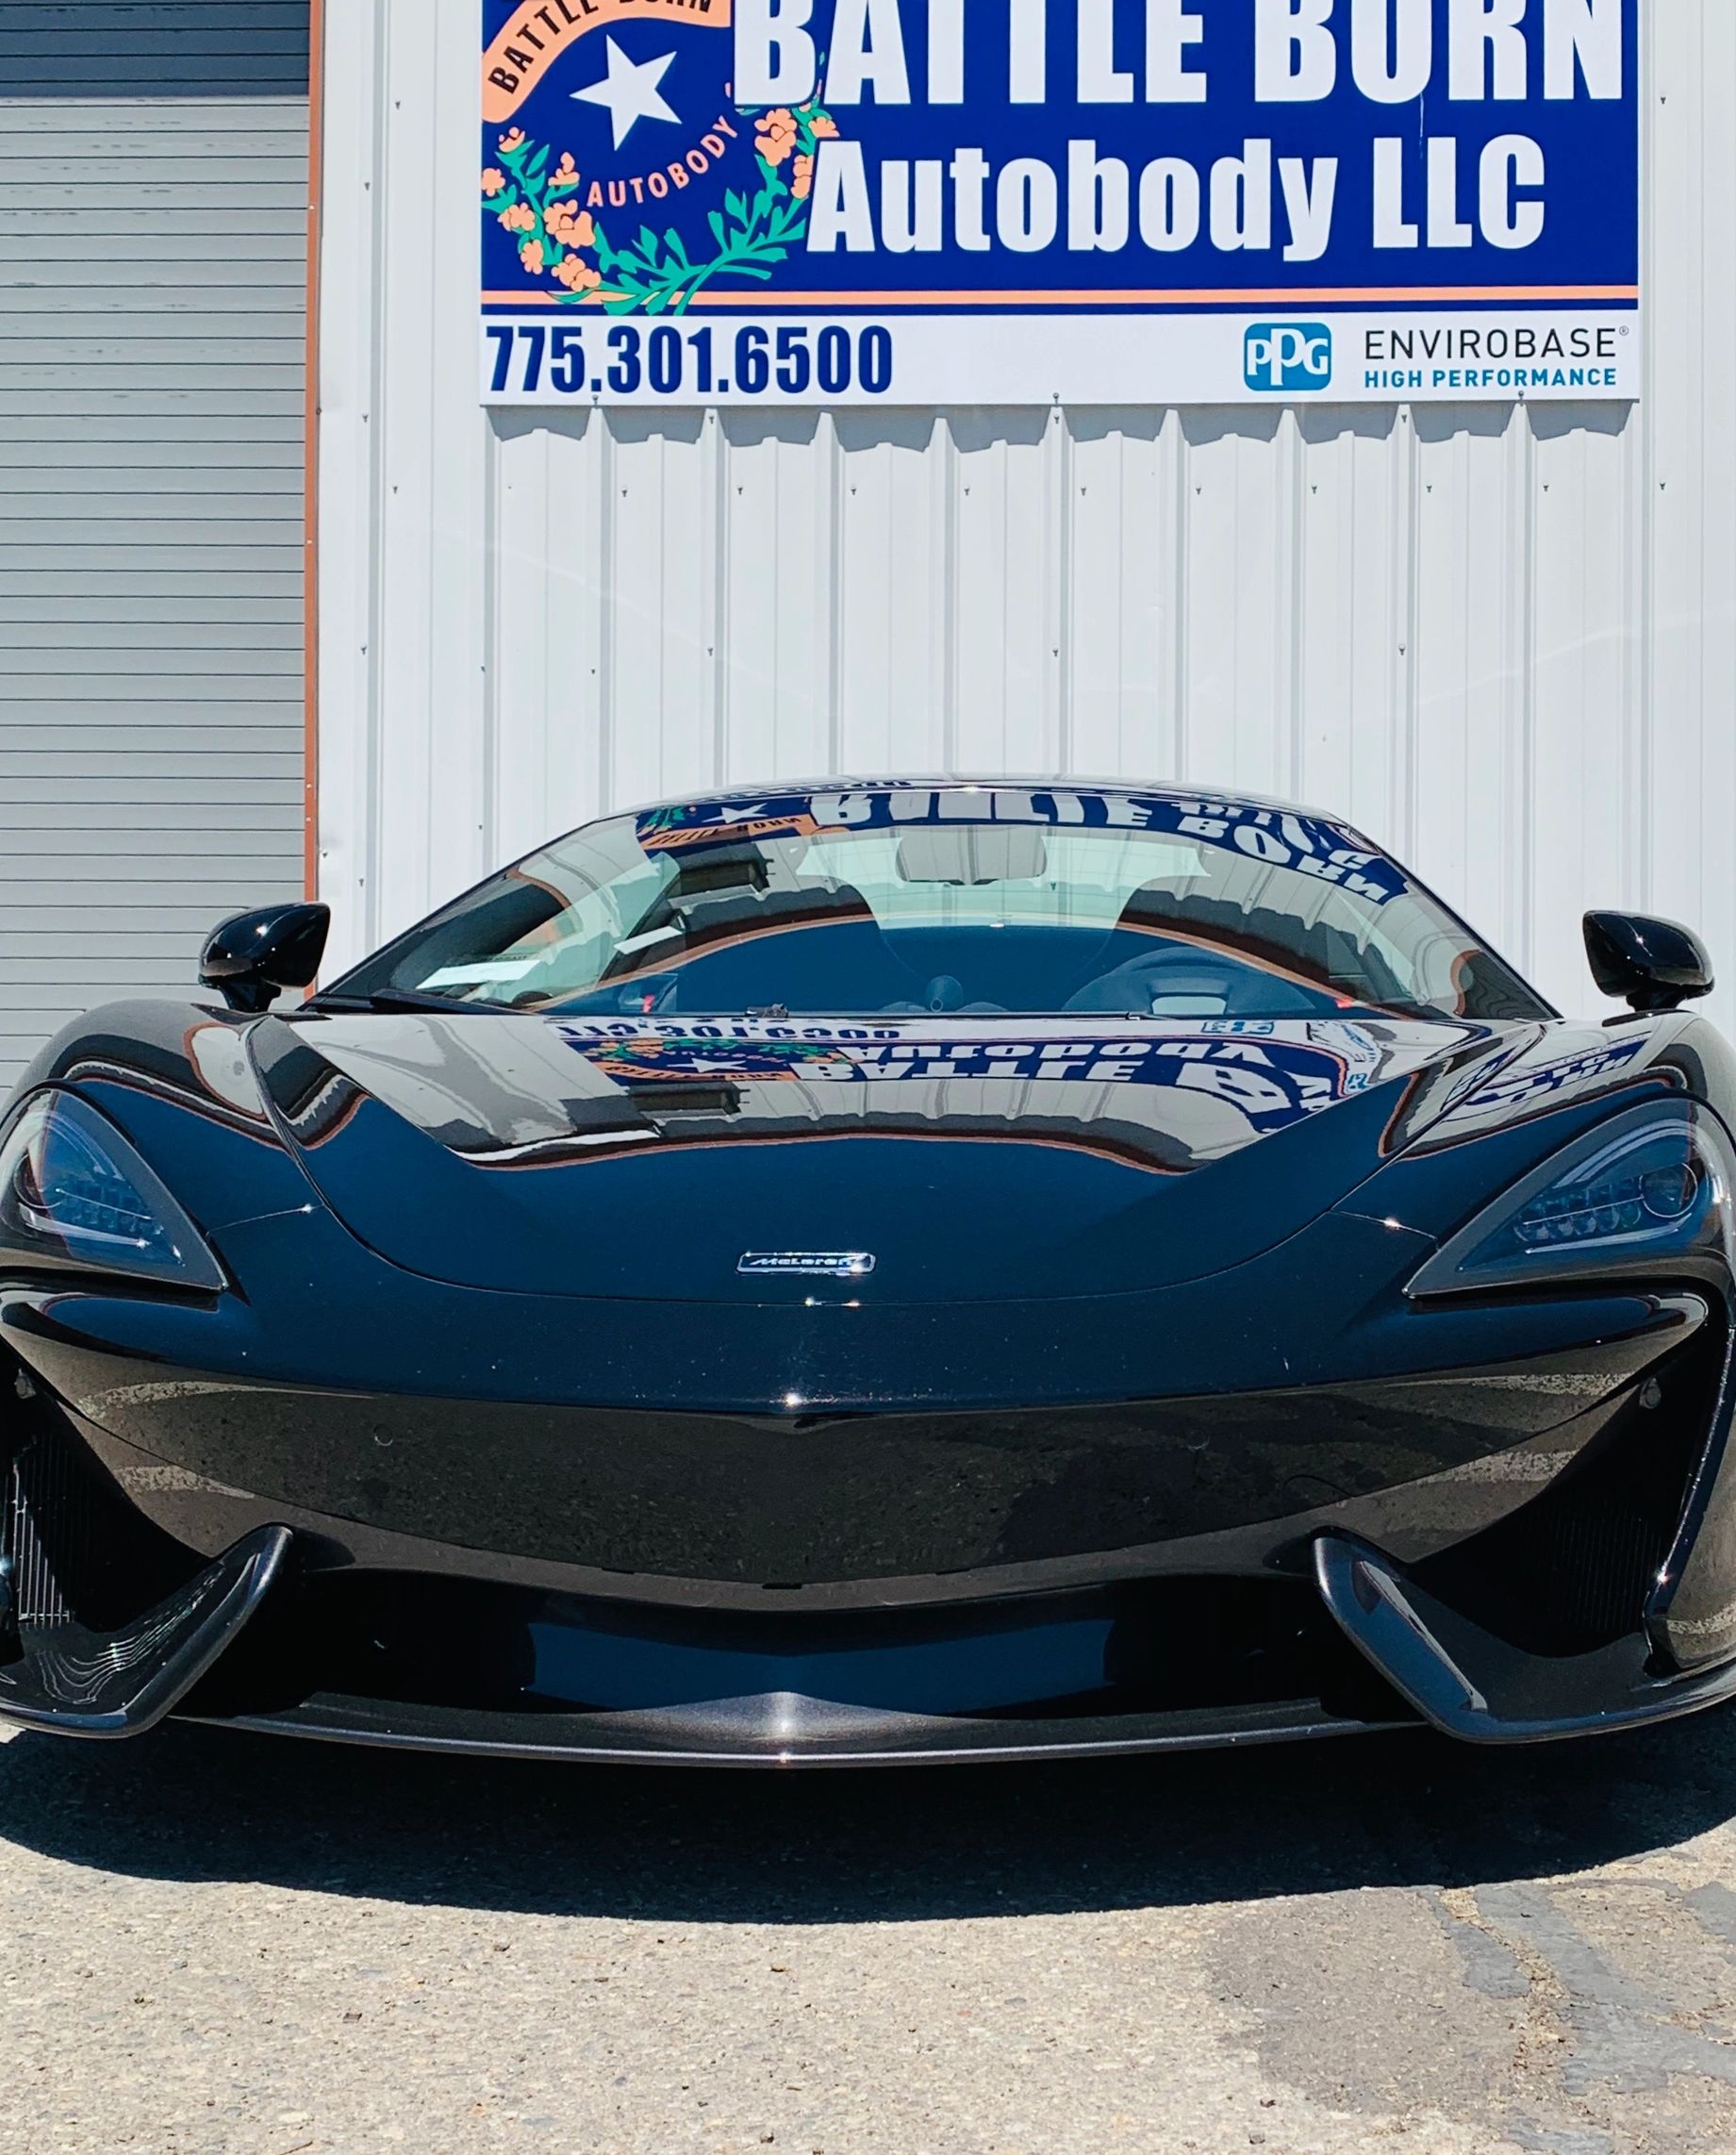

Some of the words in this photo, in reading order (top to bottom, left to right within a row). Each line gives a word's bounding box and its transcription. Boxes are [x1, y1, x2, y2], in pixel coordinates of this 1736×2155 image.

[734, 0, 1207, 106] BATTLE
[587, 116, 738, 207] AUTOBODY
[806, 139, 1338, 262] Autobody
[1373, 134, 1545, 249] LLC
[486, 324, 893, 394] 775.301.6500
[1364, 369, 1422, 389] HIGH
[1432, 368, 1616, 388] PERFORMANCE
